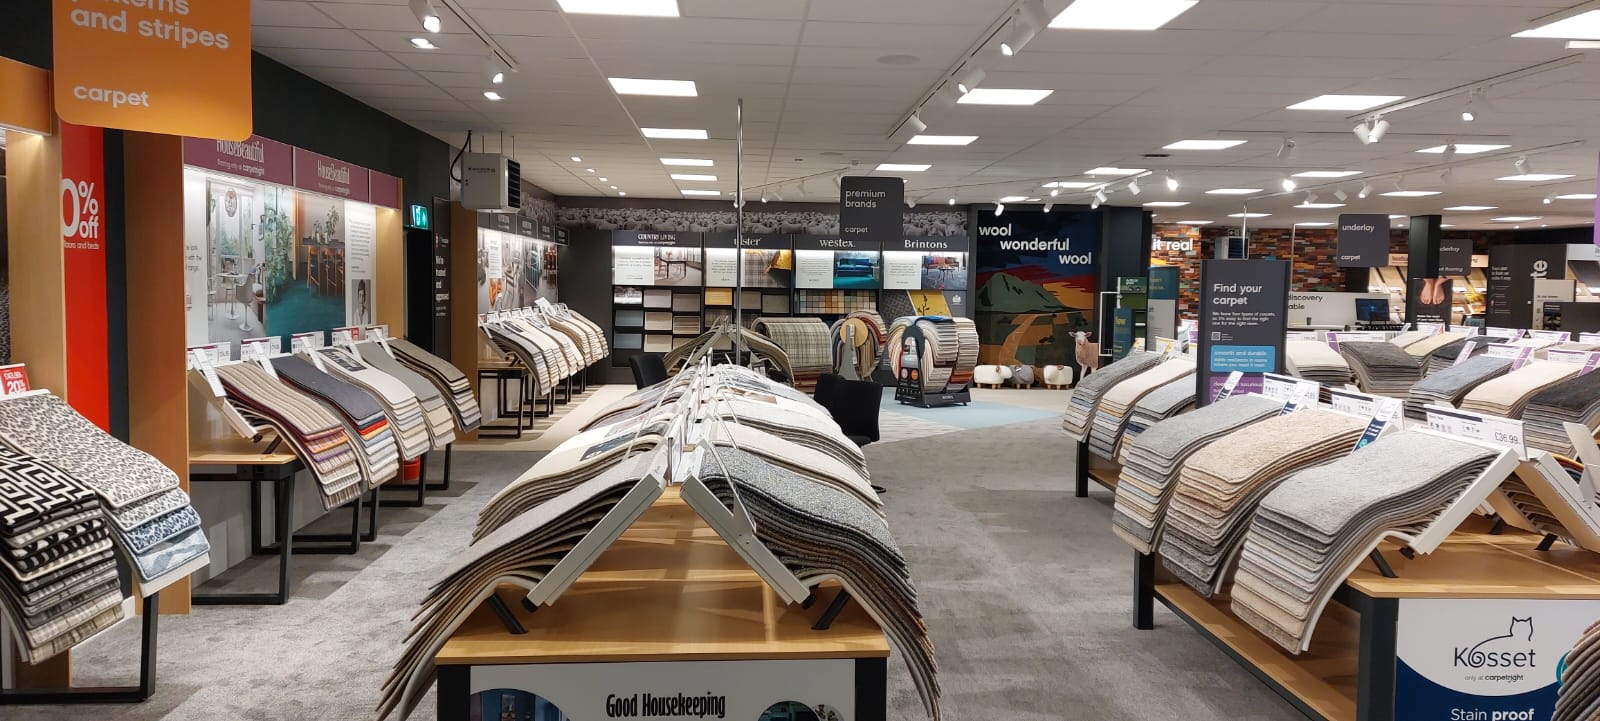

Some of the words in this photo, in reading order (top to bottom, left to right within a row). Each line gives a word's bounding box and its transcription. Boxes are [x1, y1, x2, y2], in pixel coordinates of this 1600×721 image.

[70, 8, 127, 32] and
[138, 19, 229, 49] stripes
[73, 85, 150, 108] carpet
[845, 189, 886, 199] premium
[845, 199, 877, 208] brands
[79, 215, 99, 239] off
[844, 226, 868, 234] carpet
[979, 223, 1012, 236] wool
[1342, 223, 1375, 233] underlay
[904, 239, 948, 249] Brintons
[999, 237, 1070, 251] wonderful
[1166, 238, 1193, 251] real
[1058, 251, 1092, 265] wool
[1340, 254, 1361, 262] carpet
[1213, 283, 1237, 293] Find
[1240, 284, 1263, 295] your
[1212, 296, 1248, 307] carpet
[1287, 293, 1323, 303] discovery
[1453, 647, 1536, 668] Kosset
[1464, 674, 1477, 682] only
[1484, 674, 1524, 683] carpetright
[606, 693, 638, 718] Good
[642, 691, 726, 719] Housekeeping
[1450, 708, 1488, 721] Stain
[1492, 708, 1536, 721] proof
